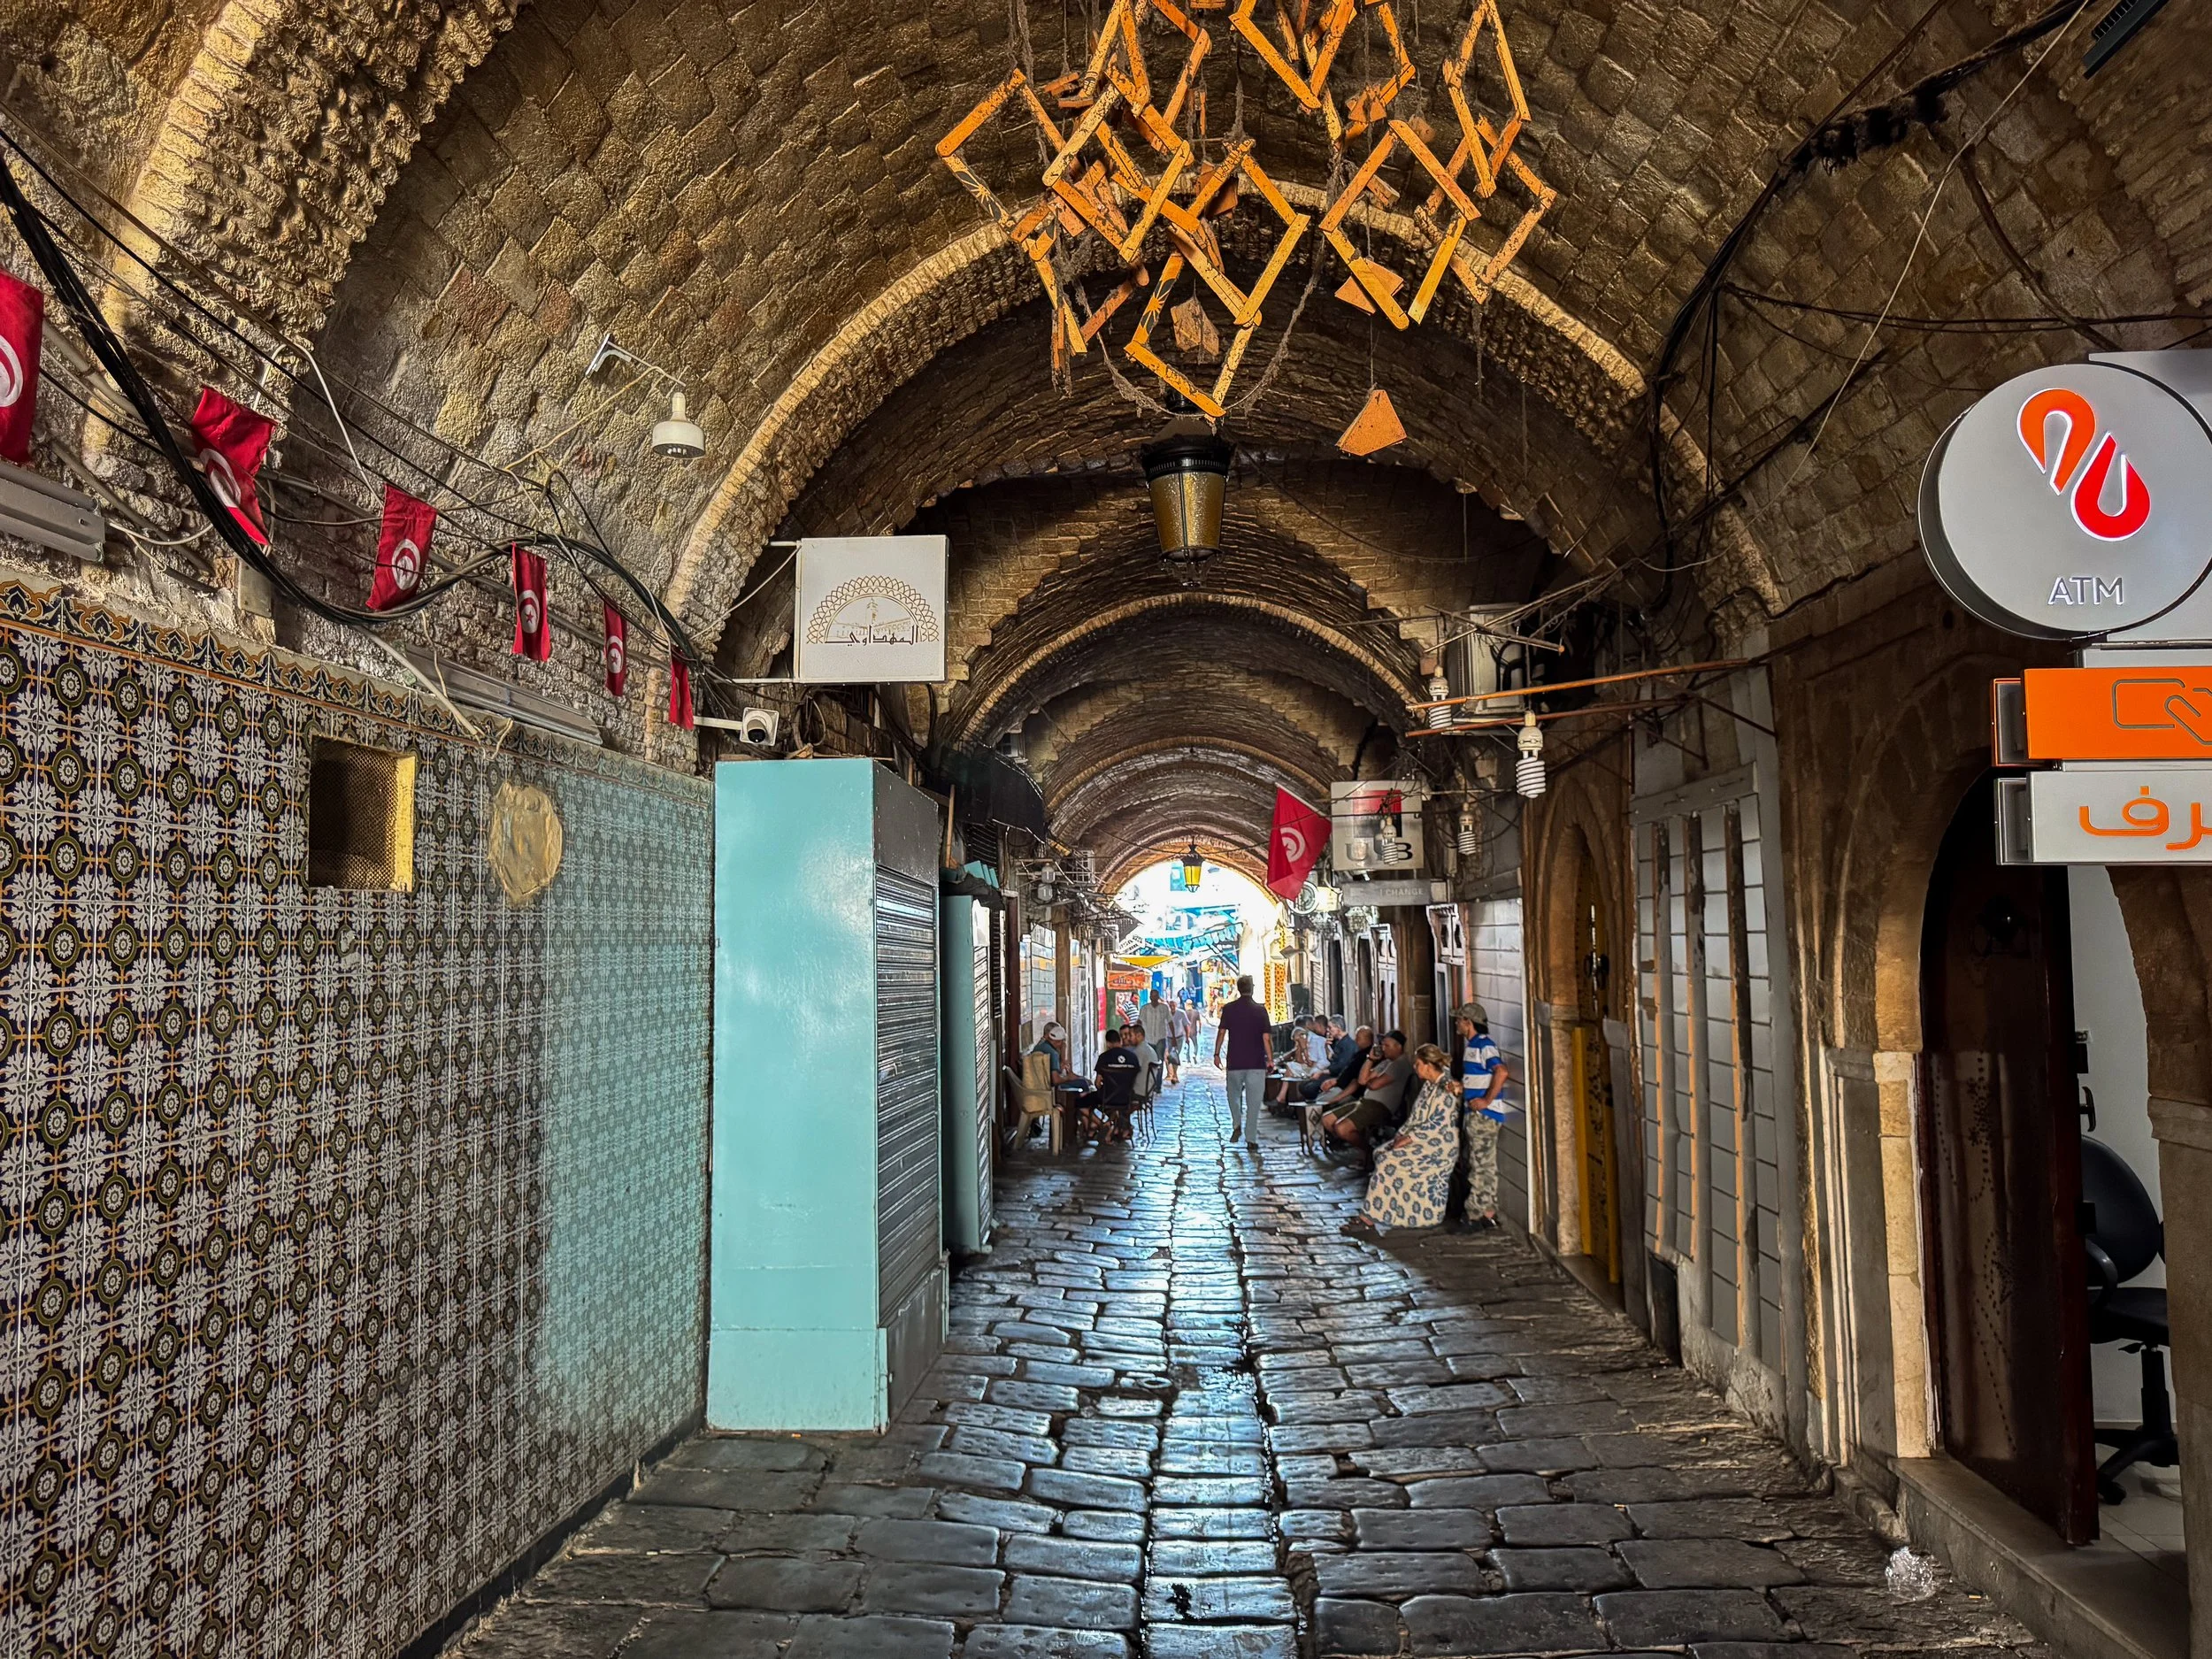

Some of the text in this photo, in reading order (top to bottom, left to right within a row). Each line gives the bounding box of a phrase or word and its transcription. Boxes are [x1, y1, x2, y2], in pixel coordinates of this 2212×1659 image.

[2047, 576, 2125, 606] ATM
[825, 625, 918, 647] المهداوي
[2078, 785, 2212, 851] رف
[1385, 887, 1424, 896] CHANGE
